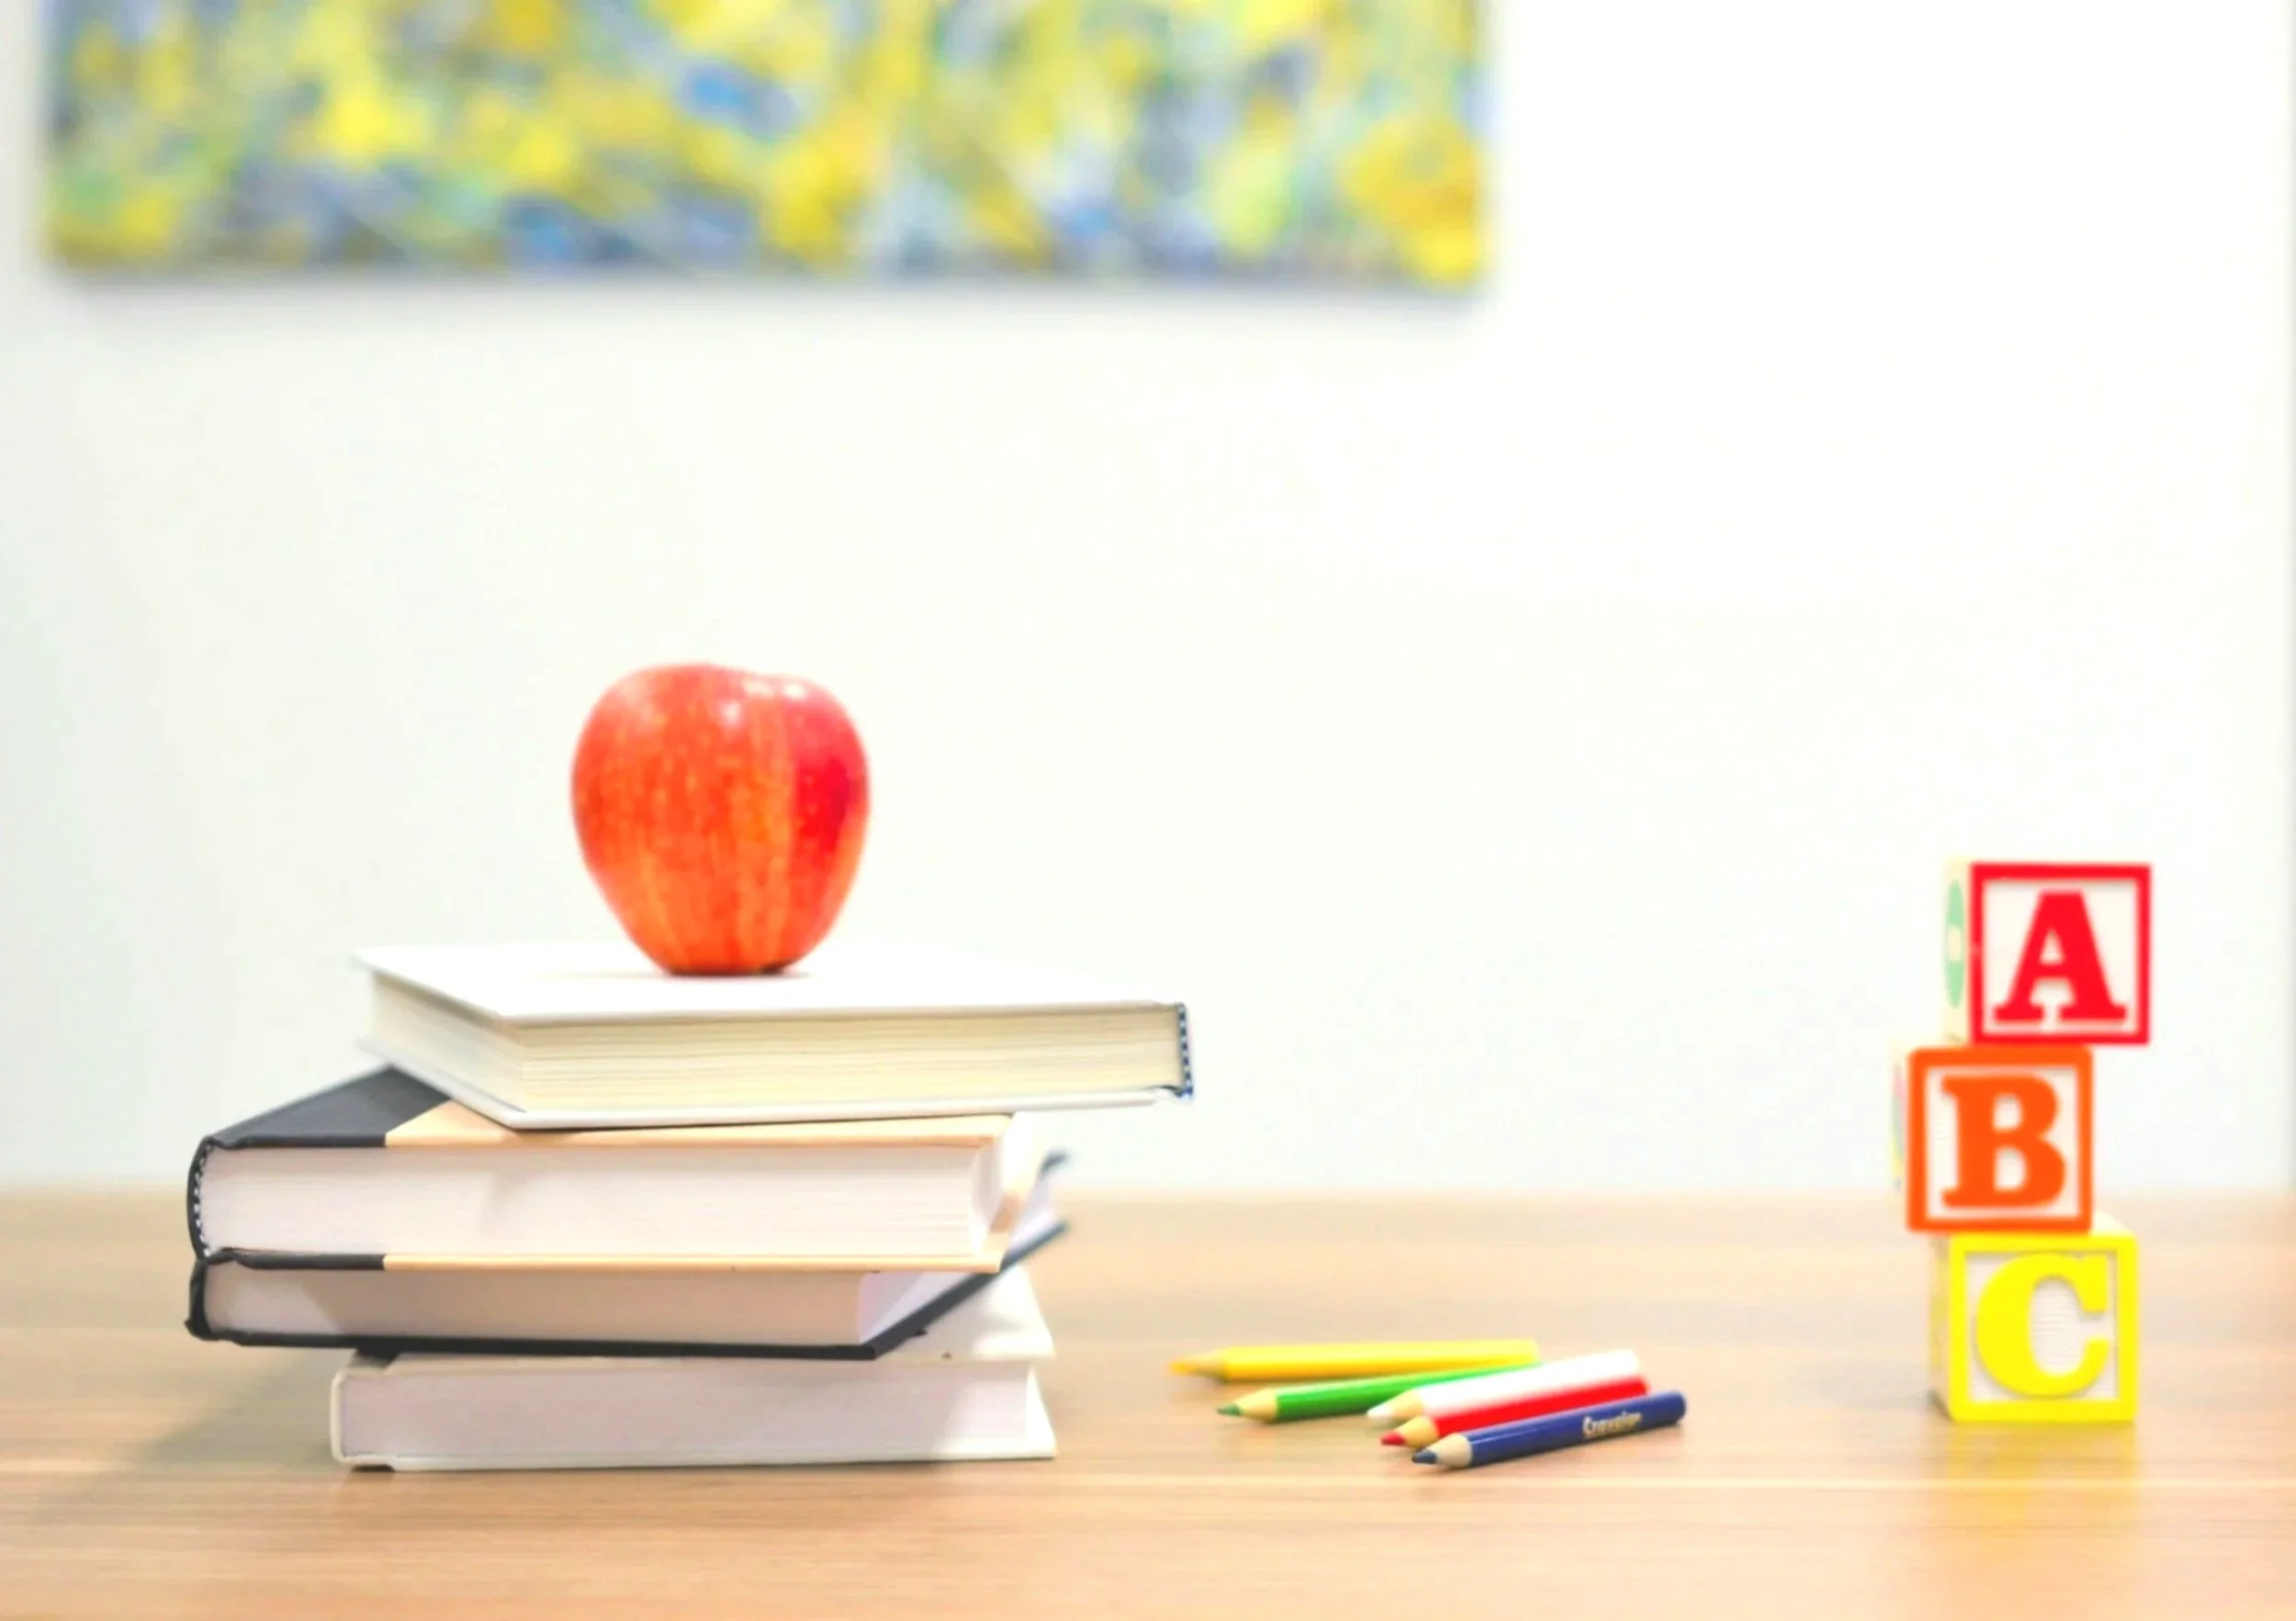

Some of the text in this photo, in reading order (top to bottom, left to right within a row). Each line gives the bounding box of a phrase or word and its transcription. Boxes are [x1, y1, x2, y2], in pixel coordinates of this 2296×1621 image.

[1993, 889, 2127, 1023] A
[1941, 1073, 2066, 1210] B
[1975, 1253, 2110, 1399] C
